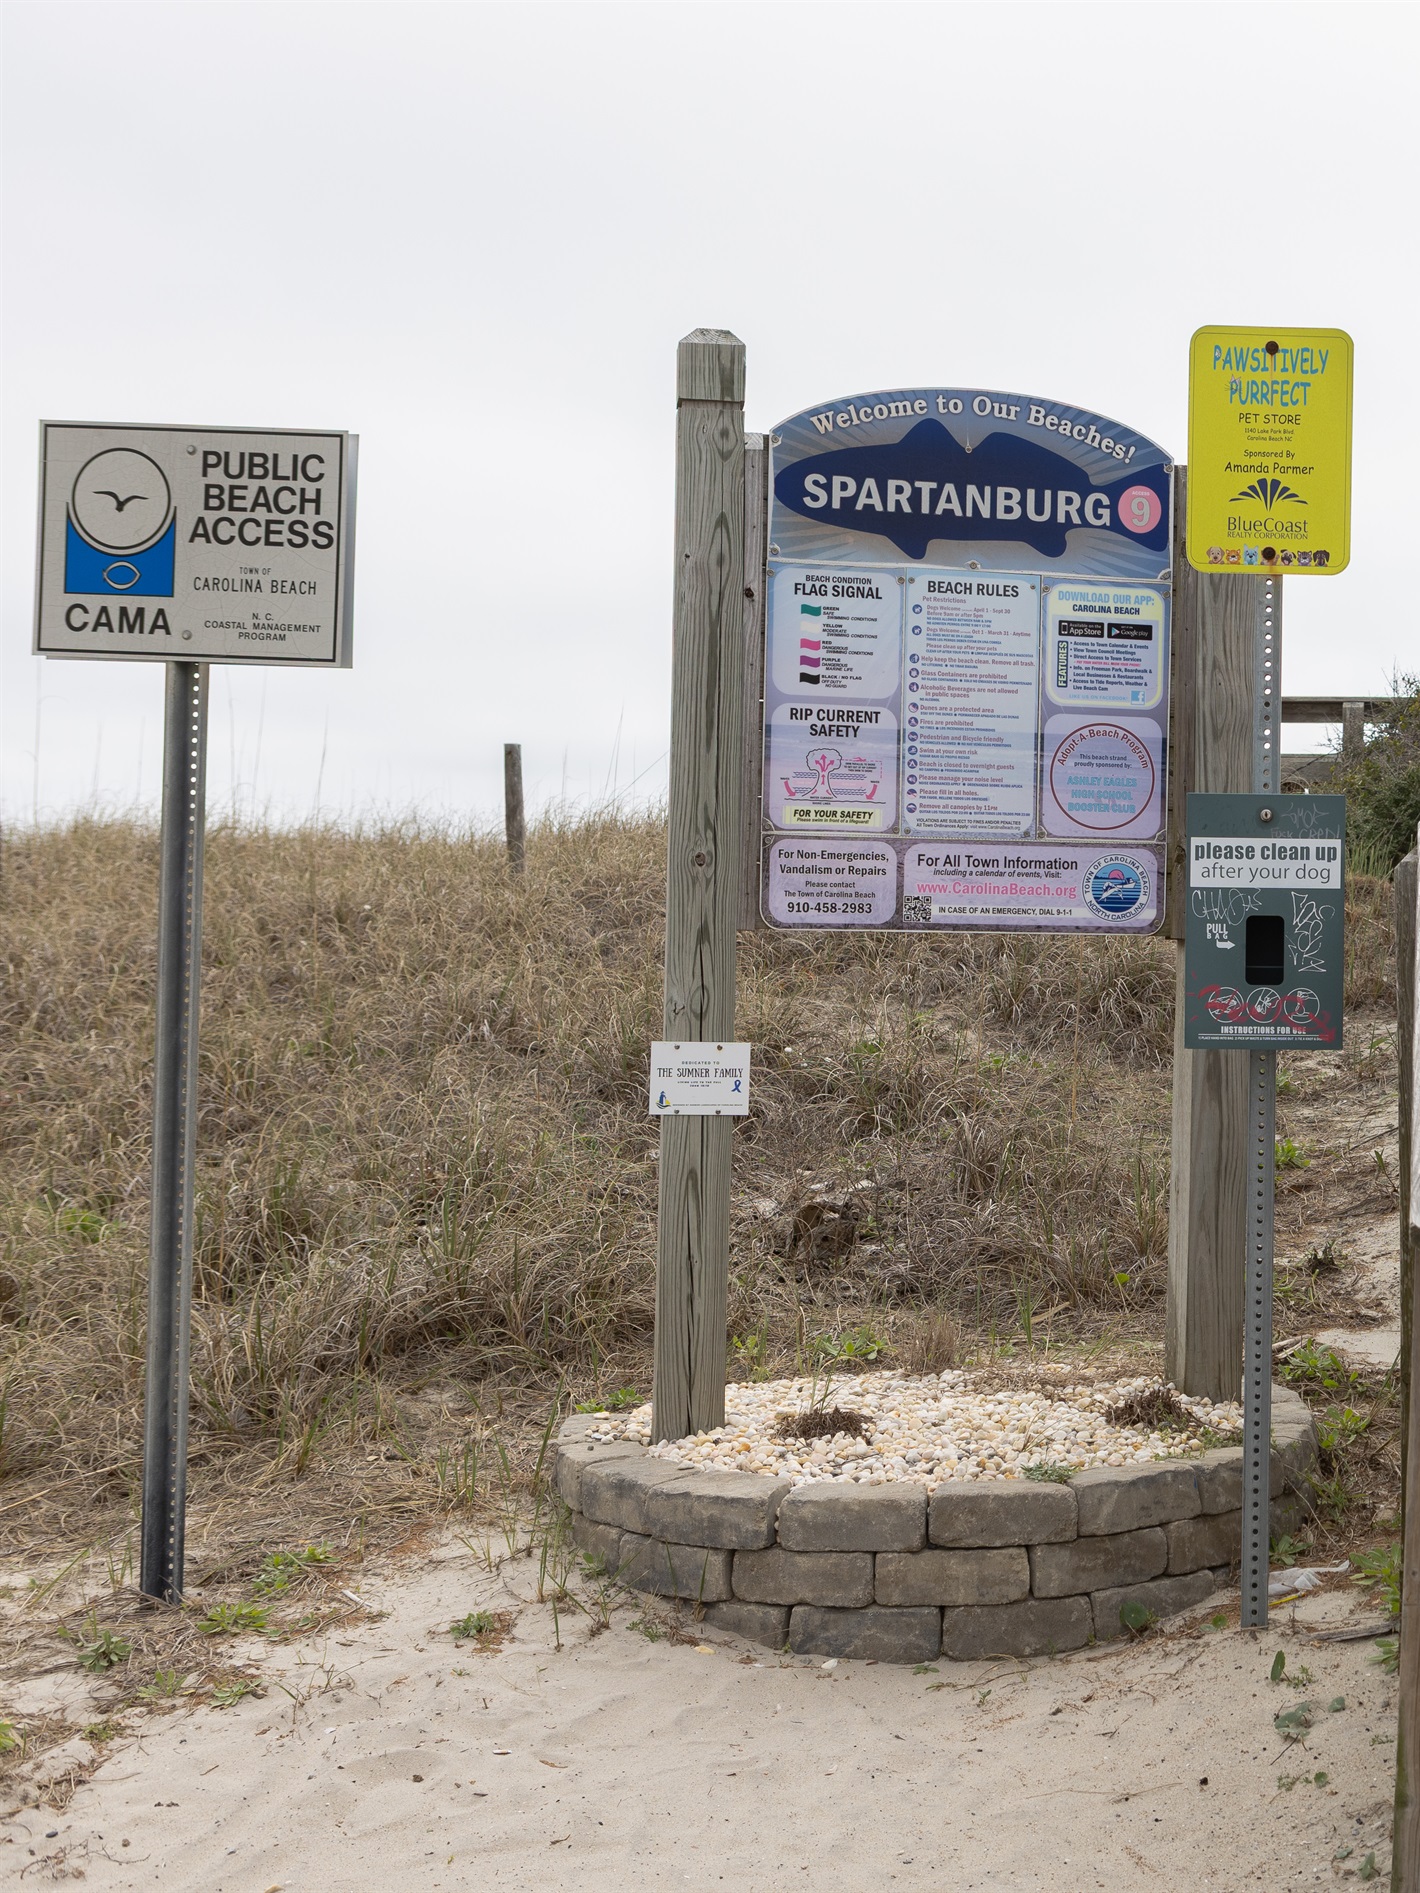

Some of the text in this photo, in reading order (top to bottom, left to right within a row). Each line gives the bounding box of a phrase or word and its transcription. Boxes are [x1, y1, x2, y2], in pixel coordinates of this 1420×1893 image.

[1230, 380, 1311, 407] PURRFECT
[1239, 413, 1301, 425] PET STORE
[810, 395, 1137, 464] Welcome to Our Beaches!
[1244, 449, 1295, 460] Sponsored By
[202, 450, 325, 483] PUBLIC
[1224, 462, 1314, 474] Amanda Parmer
[203, 484, 322, 515] BEACH
[802, 472, 1111, 527] SPARTANBURG
[1130, 496, 1151, 527] 9
[1227, 516, 1309, 533] BlueCoast
[188, 516, 334, 550] ACCESS
[1254, 532, 1309, 540] CORPORATION
[239, 567, 271, 576] TOWN OF
[194, 577, 317, 595] CAROLINA BEACH
[832, 576, 872, 584] CONDITION
[794, 583, 882, 600] FLAG SIGNAL
[928, 580, 1019, 597] BEACH RULES
[1058, 591, 1155, 606] DOWNLOAD OUR APP:
[1073, 604, 1140, 615] CAROLINA BEACH
[64, 602, 172, 636] CAMA
[204, 620, 321, 633] COASTAL MANAGEMENT
[1084, 628, 1101, 636] Store
[1121, 629, 1138, 637] Google
[238, 632, 286, 642] PROGRAM
[1059, 642, 1067, 686] FEATURES
[790, 708, 880, 723] RIP CURRENT
[810, 724, 860, 737] SAFETY
[1058, 729, 1148, 769] Adopt-A-Beach Program
[1067, 776, 1137, 787] ASHLEY EAGLES
[1071, 790, 1133, 800] HIGH SCHOOL
[794, 809, 873, 819] FOR YOUR SAFETY
[1068, 802, 1136, 813] BOOSTER CLUB
[778, 849, 889, 862] For Non-Emergencies,
[1195, 842, 1337, 862] please clean up
[917, 854, 1078, 870] For All Town Information
[780, 864, 887, 877] Vandalism or Repairs
[933, 868, 967, 878] including
[975, 870, 1006, 878] calendar
[1008, 870, 1015, 878] of
[1085, 856, 1148, 896] TOWN OF CAROLINA BEACH
[1201, 862, 1330, 884] after your dog
[917, 881, 1077, 899] www.CarolinaBeach.org
[787, 902, 872, 913] 910-458-2983
[992, 908, 1037, 916] EMERGENCY,
[1088, 900, 1144, 920] NORTH CAROLINA
[1207, 924, 1228, 933] PULL
[1221, 1026, 1306, 1034] INSTRUCTIONS FOR USE
[657, 1068, 743, 1078] THE SUMNER FAMILY
